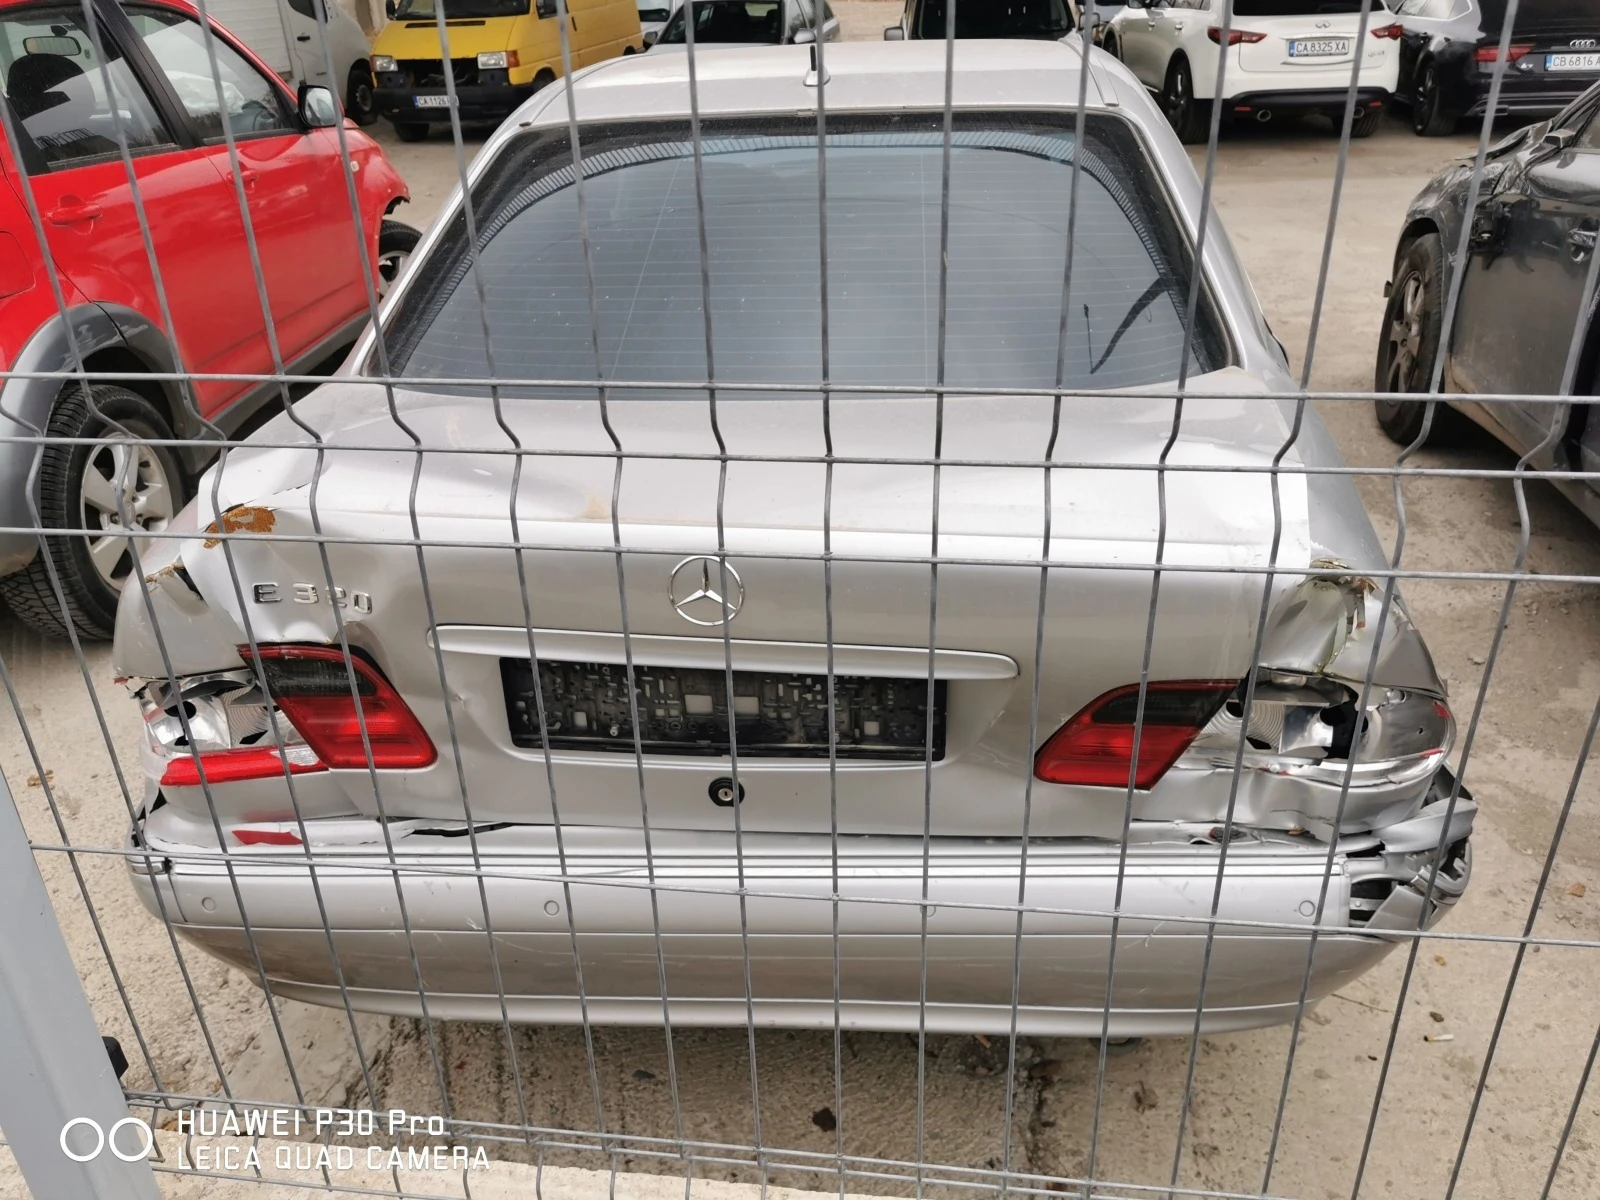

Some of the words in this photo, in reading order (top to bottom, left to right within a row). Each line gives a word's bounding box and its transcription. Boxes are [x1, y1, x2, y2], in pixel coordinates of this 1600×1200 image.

[1296, 42, 1310, 53] CA
[1310, 41, 1333, 53] 8325
[1334, 41, 1347, 52] XA
[1553, 56, 1567, 67] CB
[1568, 55, 1593, 67] 6816
[419, 97, 428, 106] CA
[252, 581, 282, 604] E
